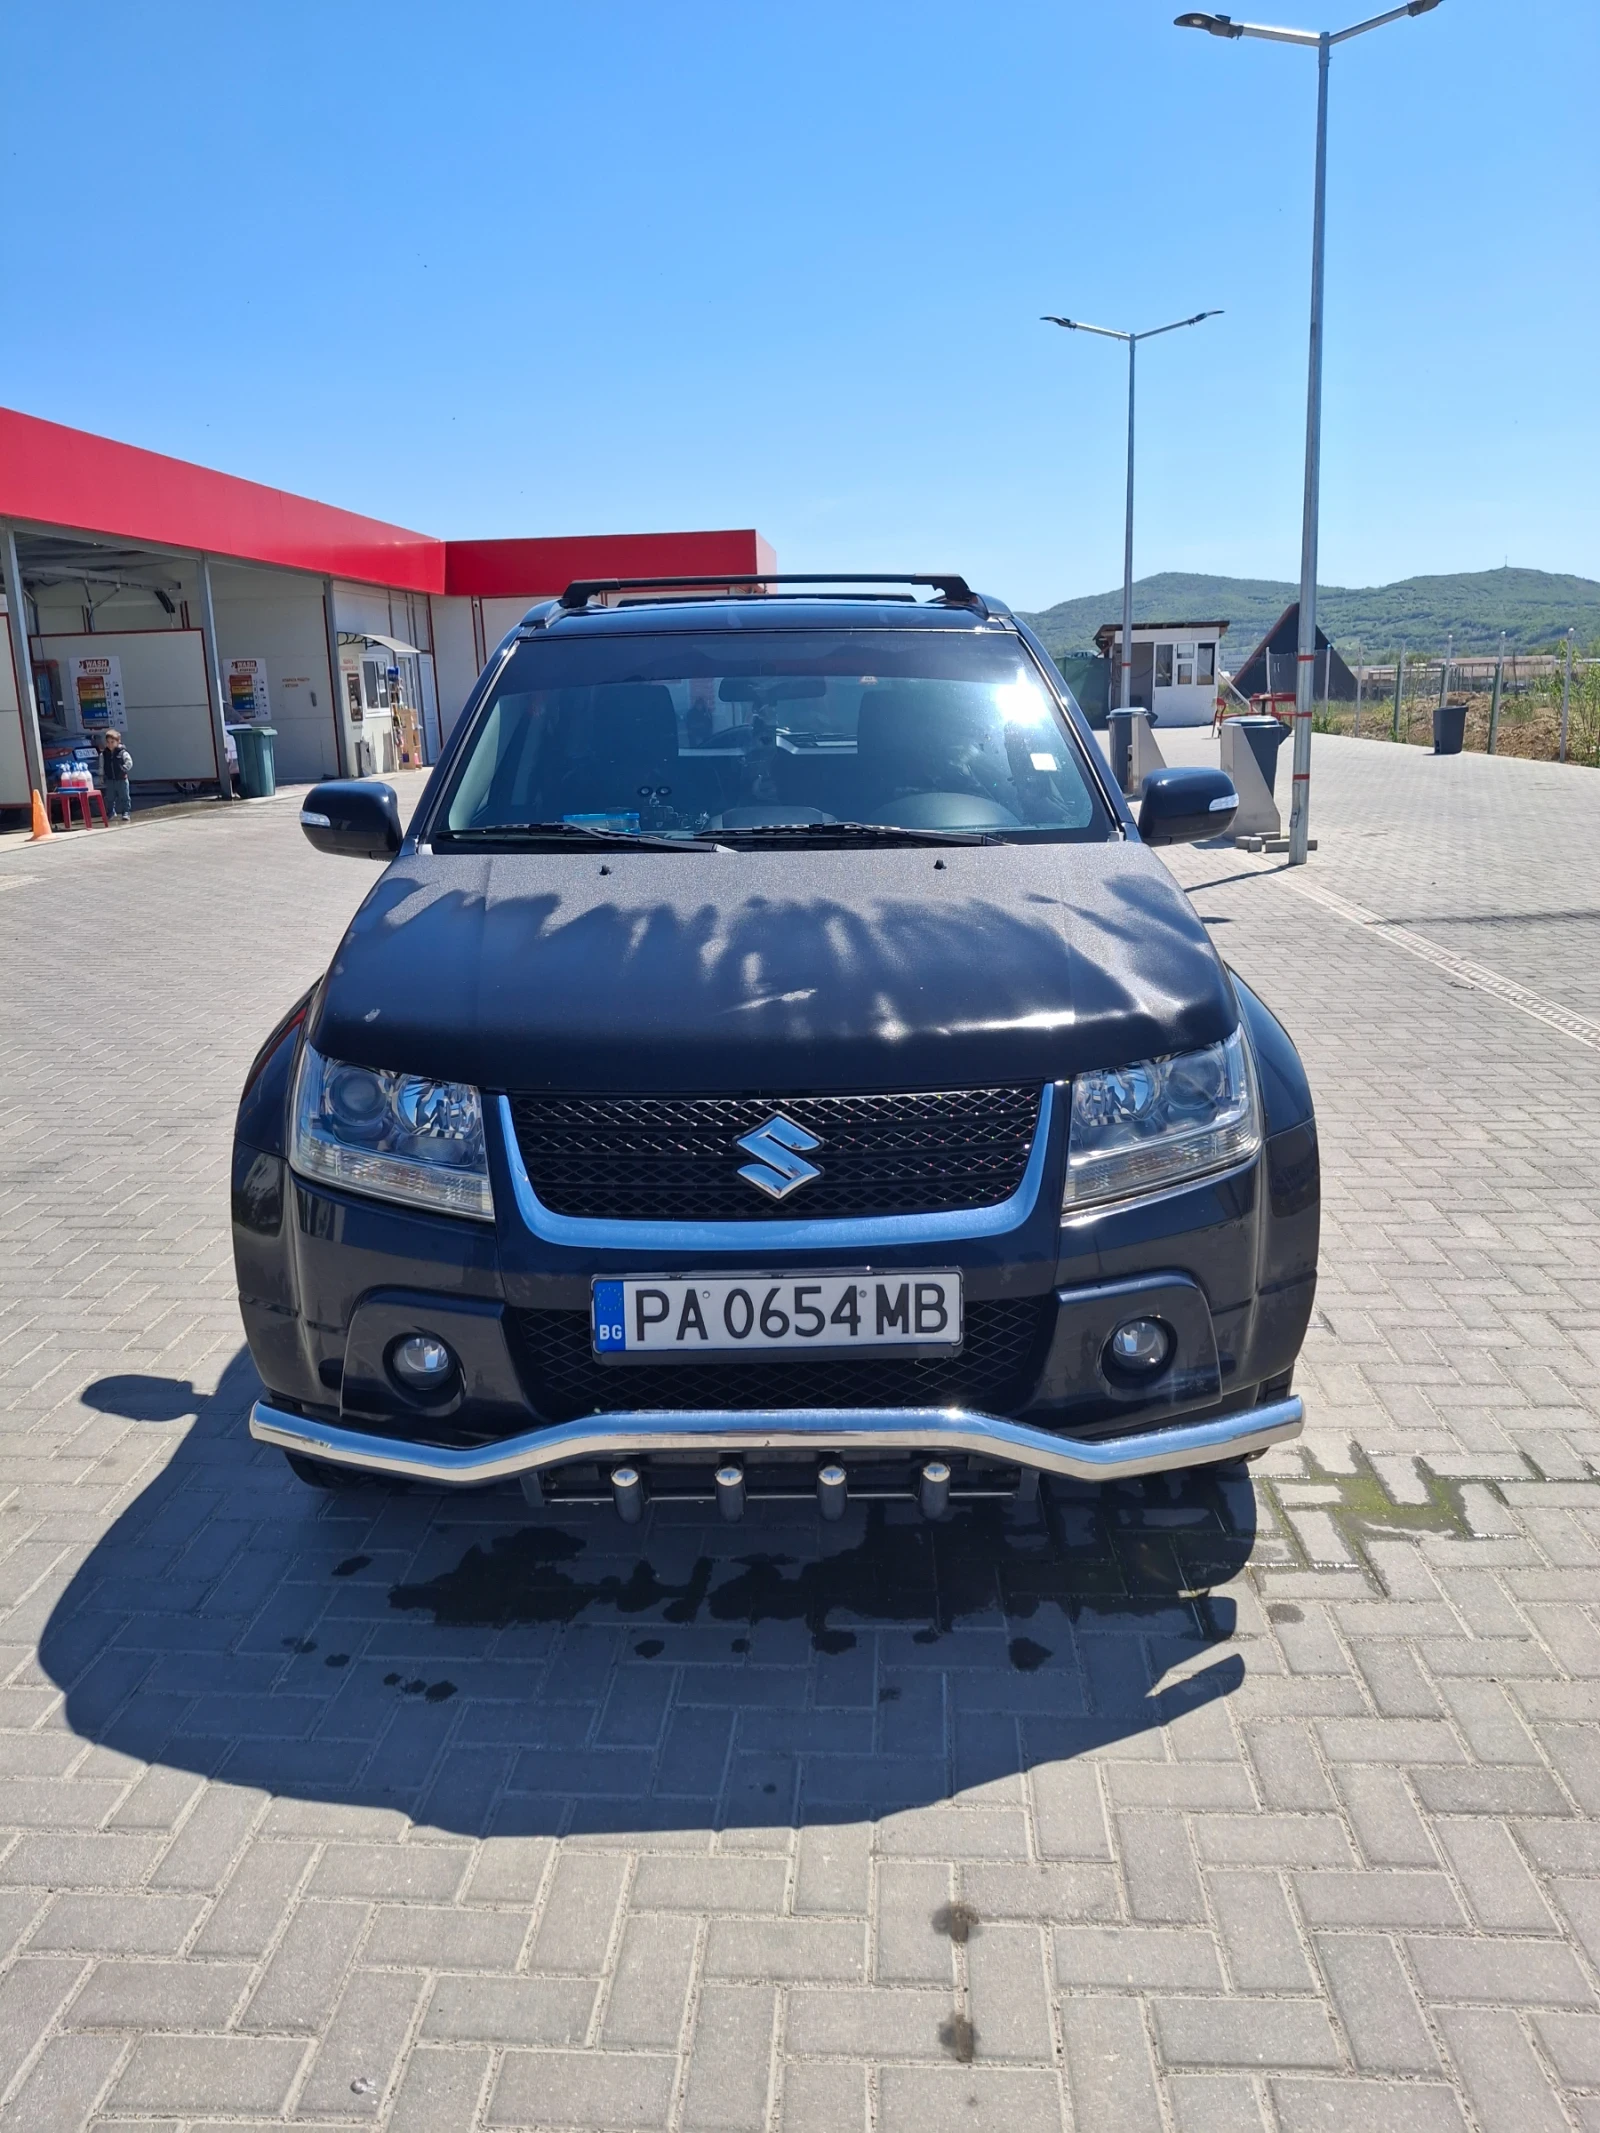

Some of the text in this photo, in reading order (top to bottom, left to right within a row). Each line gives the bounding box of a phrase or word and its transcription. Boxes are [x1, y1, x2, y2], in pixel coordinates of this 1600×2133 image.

[86, 660, 107, 668] WASH
[635, 1283, 949, 1341] PA 0654 MB
[600, 1325, 622, 1340] BG
